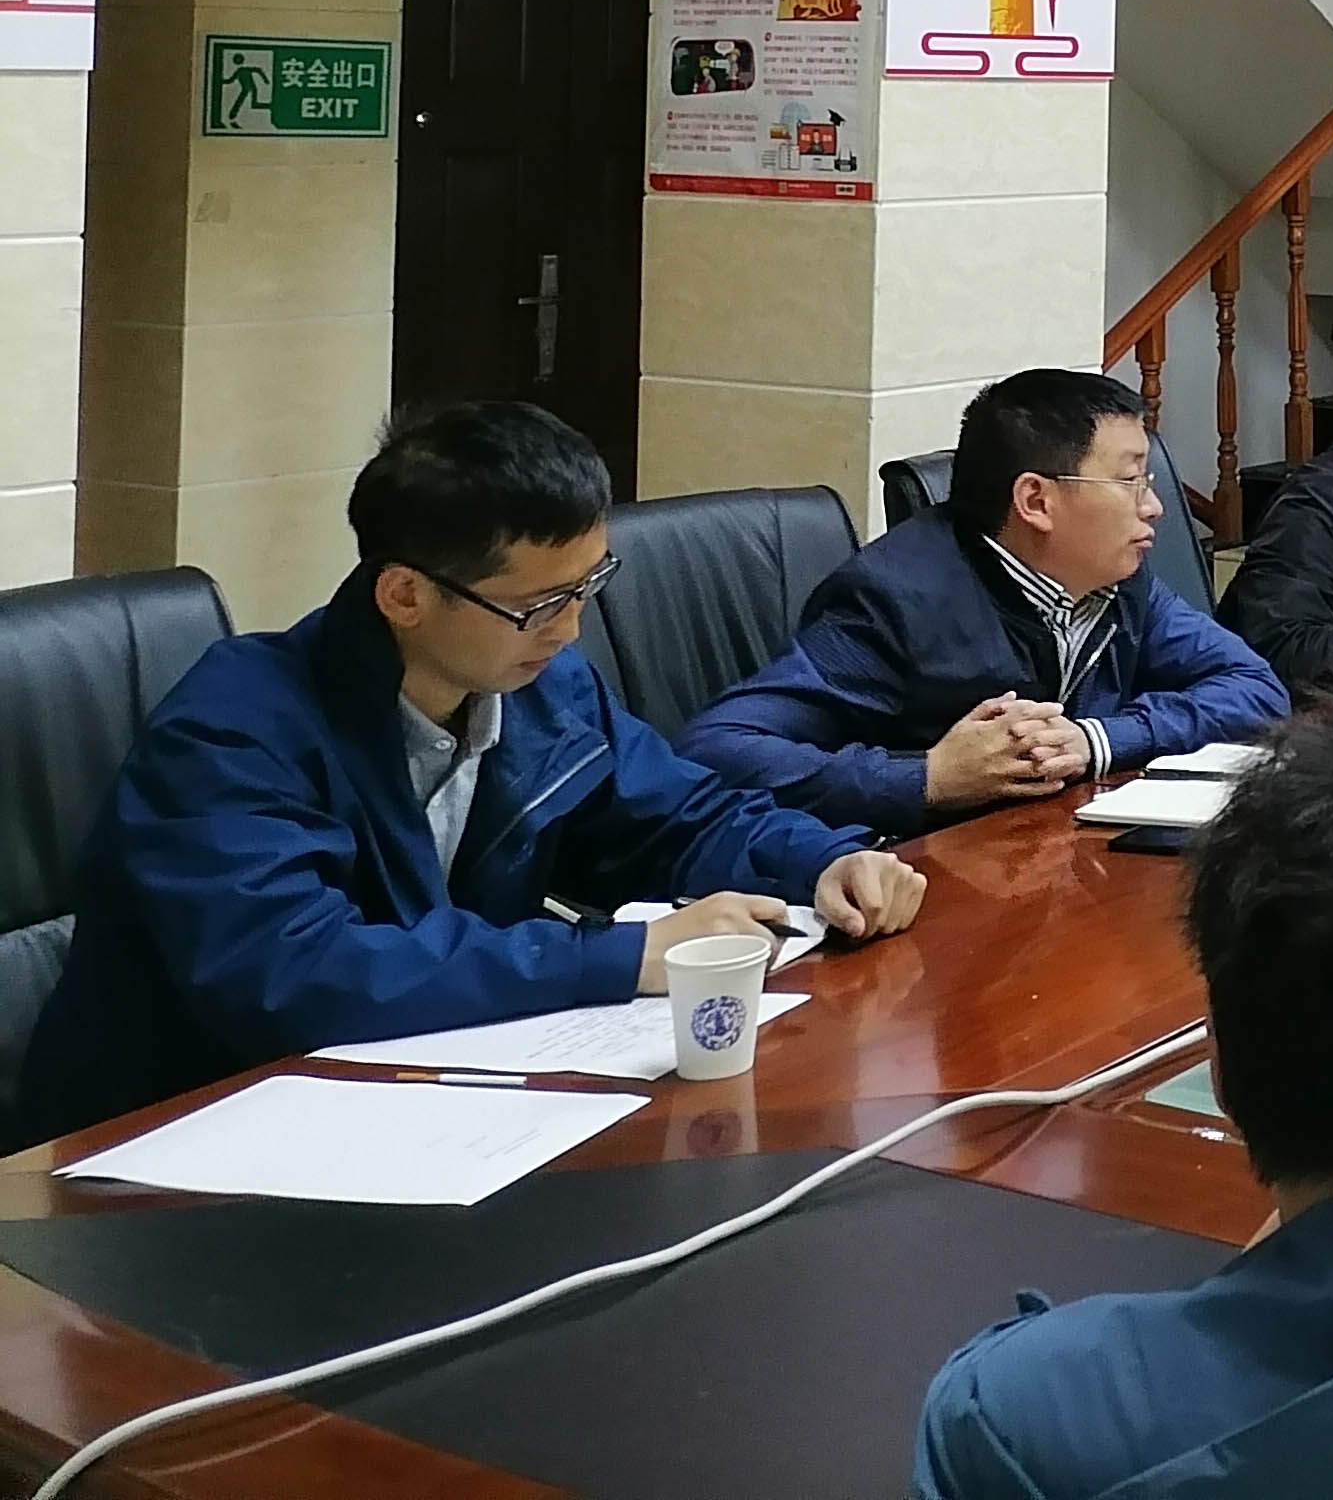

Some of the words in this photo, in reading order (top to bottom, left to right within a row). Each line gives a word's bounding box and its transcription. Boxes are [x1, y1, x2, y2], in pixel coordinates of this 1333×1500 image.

[281, 58, 376, 89] 安全出口
[301, 97, 359, 119] EXIT
